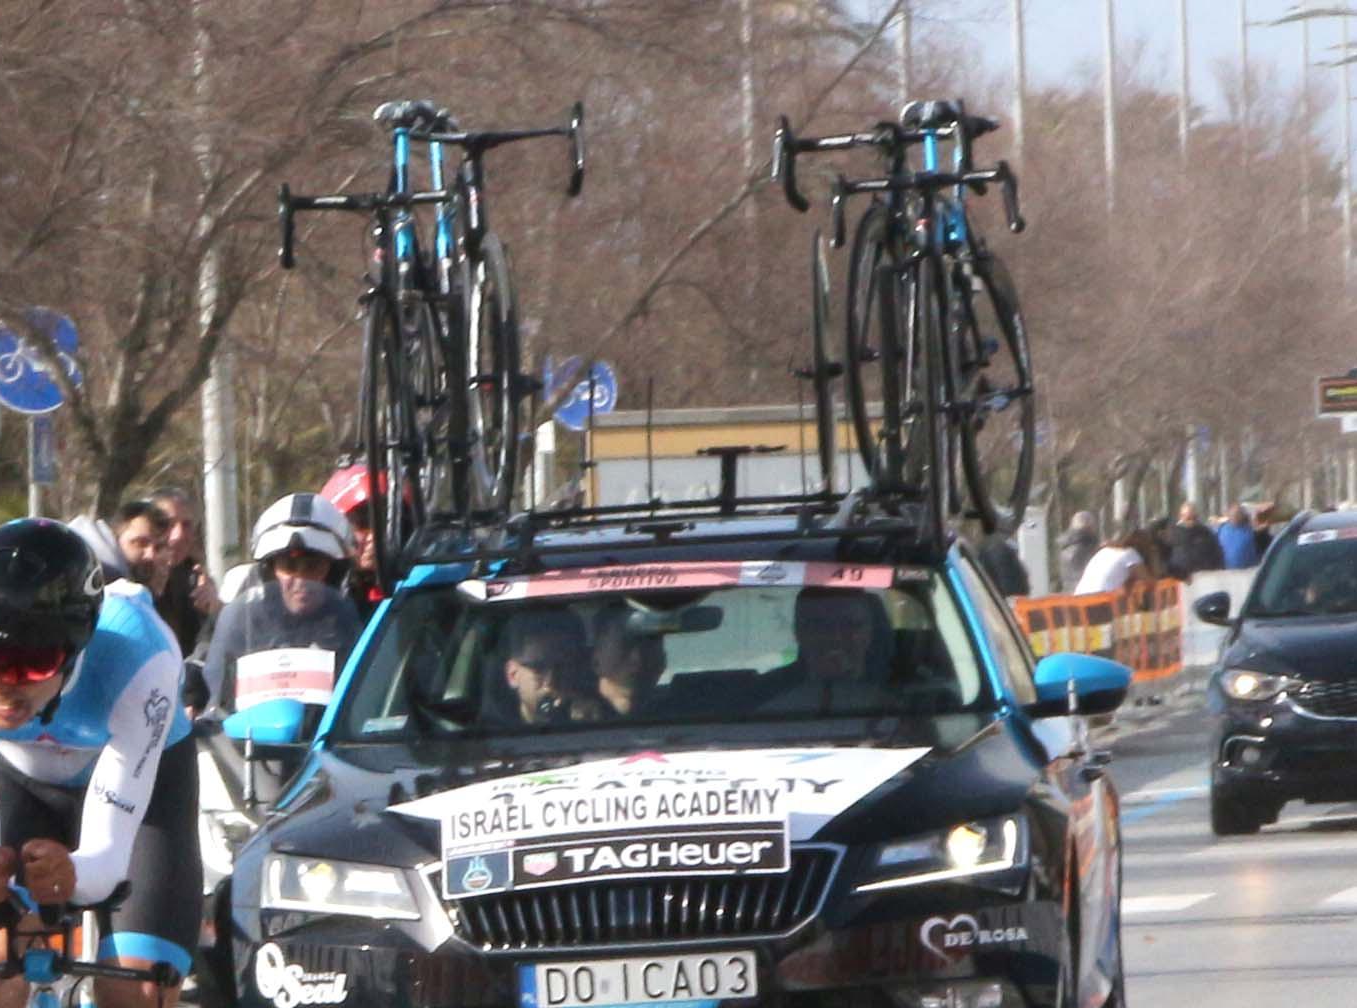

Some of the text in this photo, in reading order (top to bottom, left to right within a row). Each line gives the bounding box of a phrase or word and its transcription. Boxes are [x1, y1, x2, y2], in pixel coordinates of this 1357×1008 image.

[450, 802, 533, 840] ISRAEL
[541, 793, 648, 828] CYCLING
[656, 787, 781, 820] ACADEMY
[978, 926, 1029, 945] ROSA
